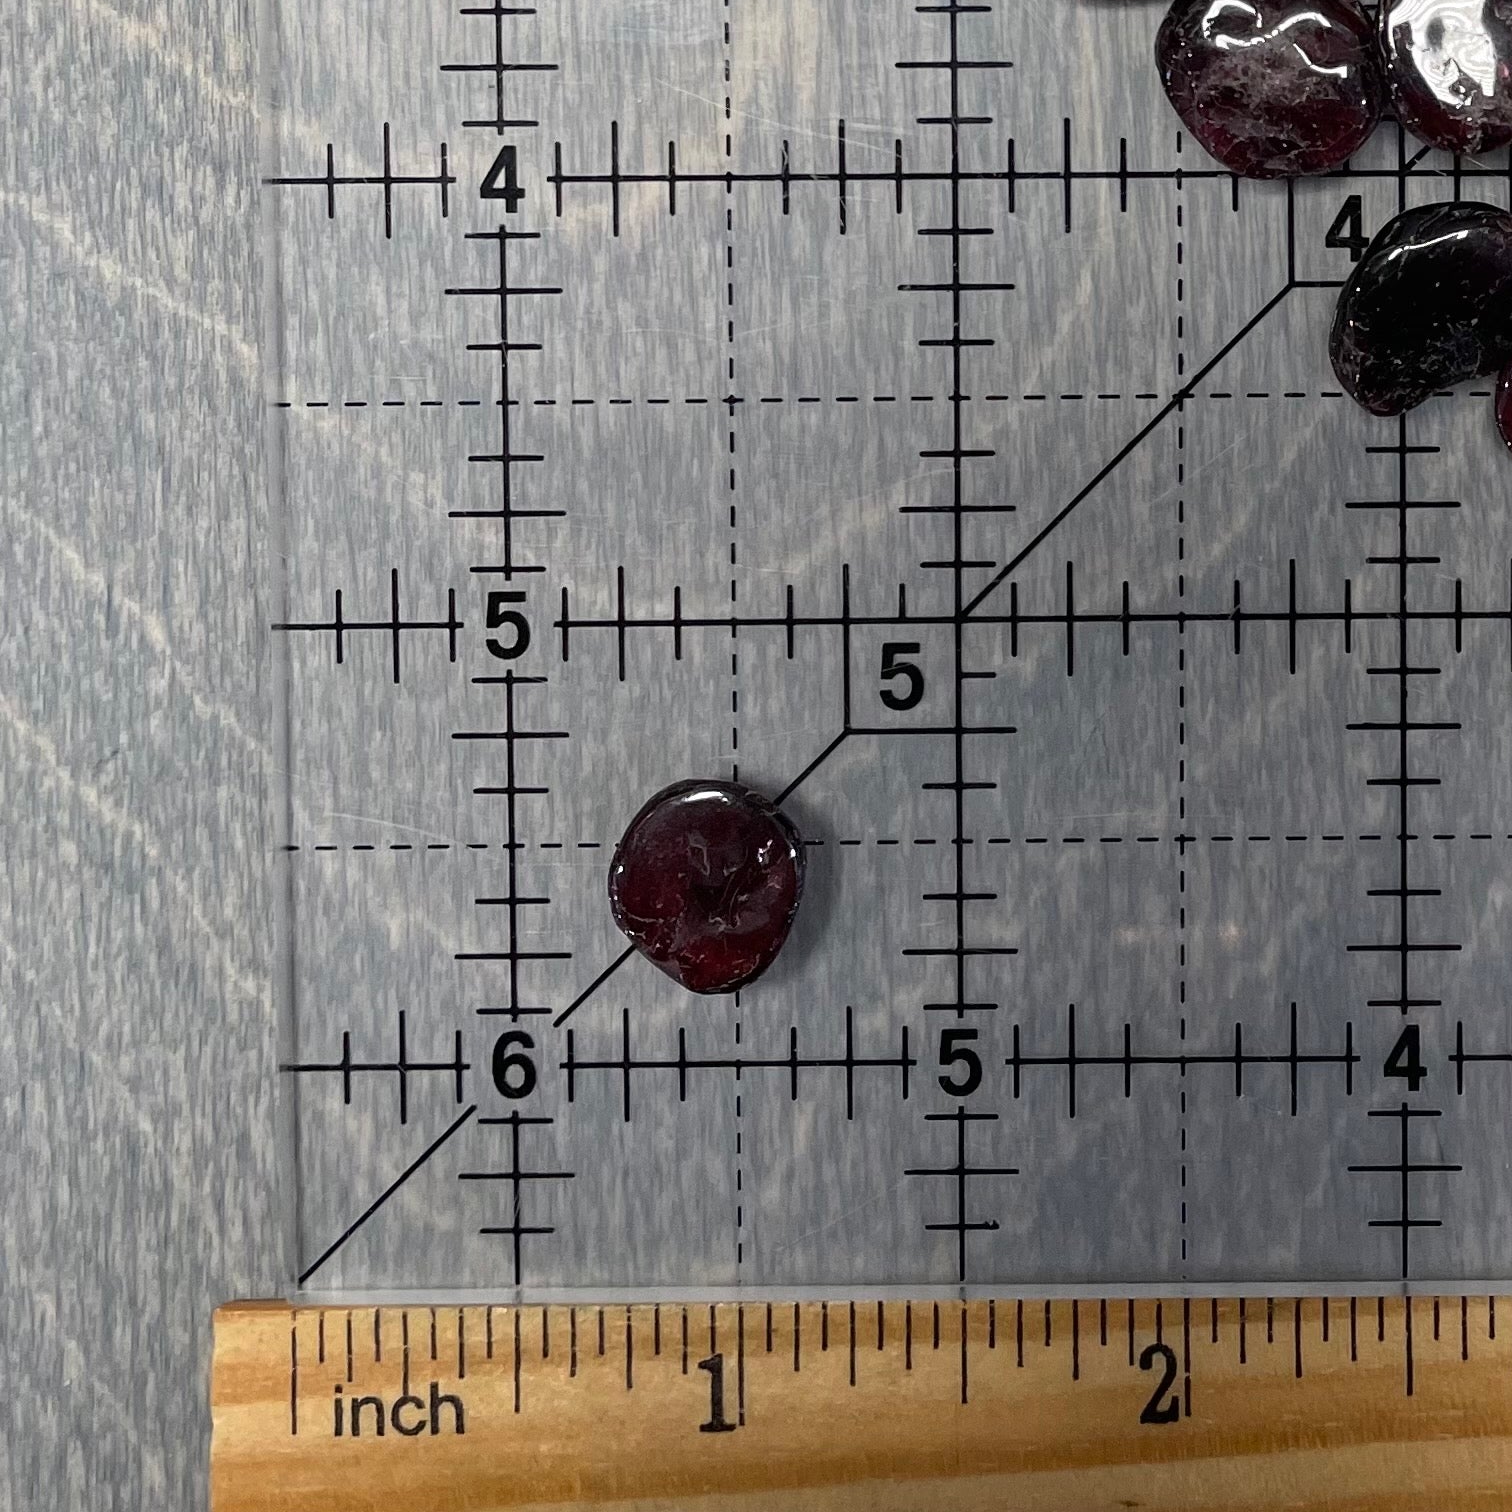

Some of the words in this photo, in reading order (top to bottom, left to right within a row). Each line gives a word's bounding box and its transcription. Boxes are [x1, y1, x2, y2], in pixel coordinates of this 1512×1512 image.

[480, 146, 525, 213] 4
[1325, 195, 1369, 262] 4
[486, 592, 530, 659] 5
[880, 643, 924, 711] 5
[492, 1031, 536, 1099] 6
[939, 1029, 982, 1096] 5
[1384, 1025, 1427, 1091] 4
[335, 1376, 465, 1437] inch
[698, 1354, 735, 1433] 1
[1140, 1344, 1179, 1424] 2
